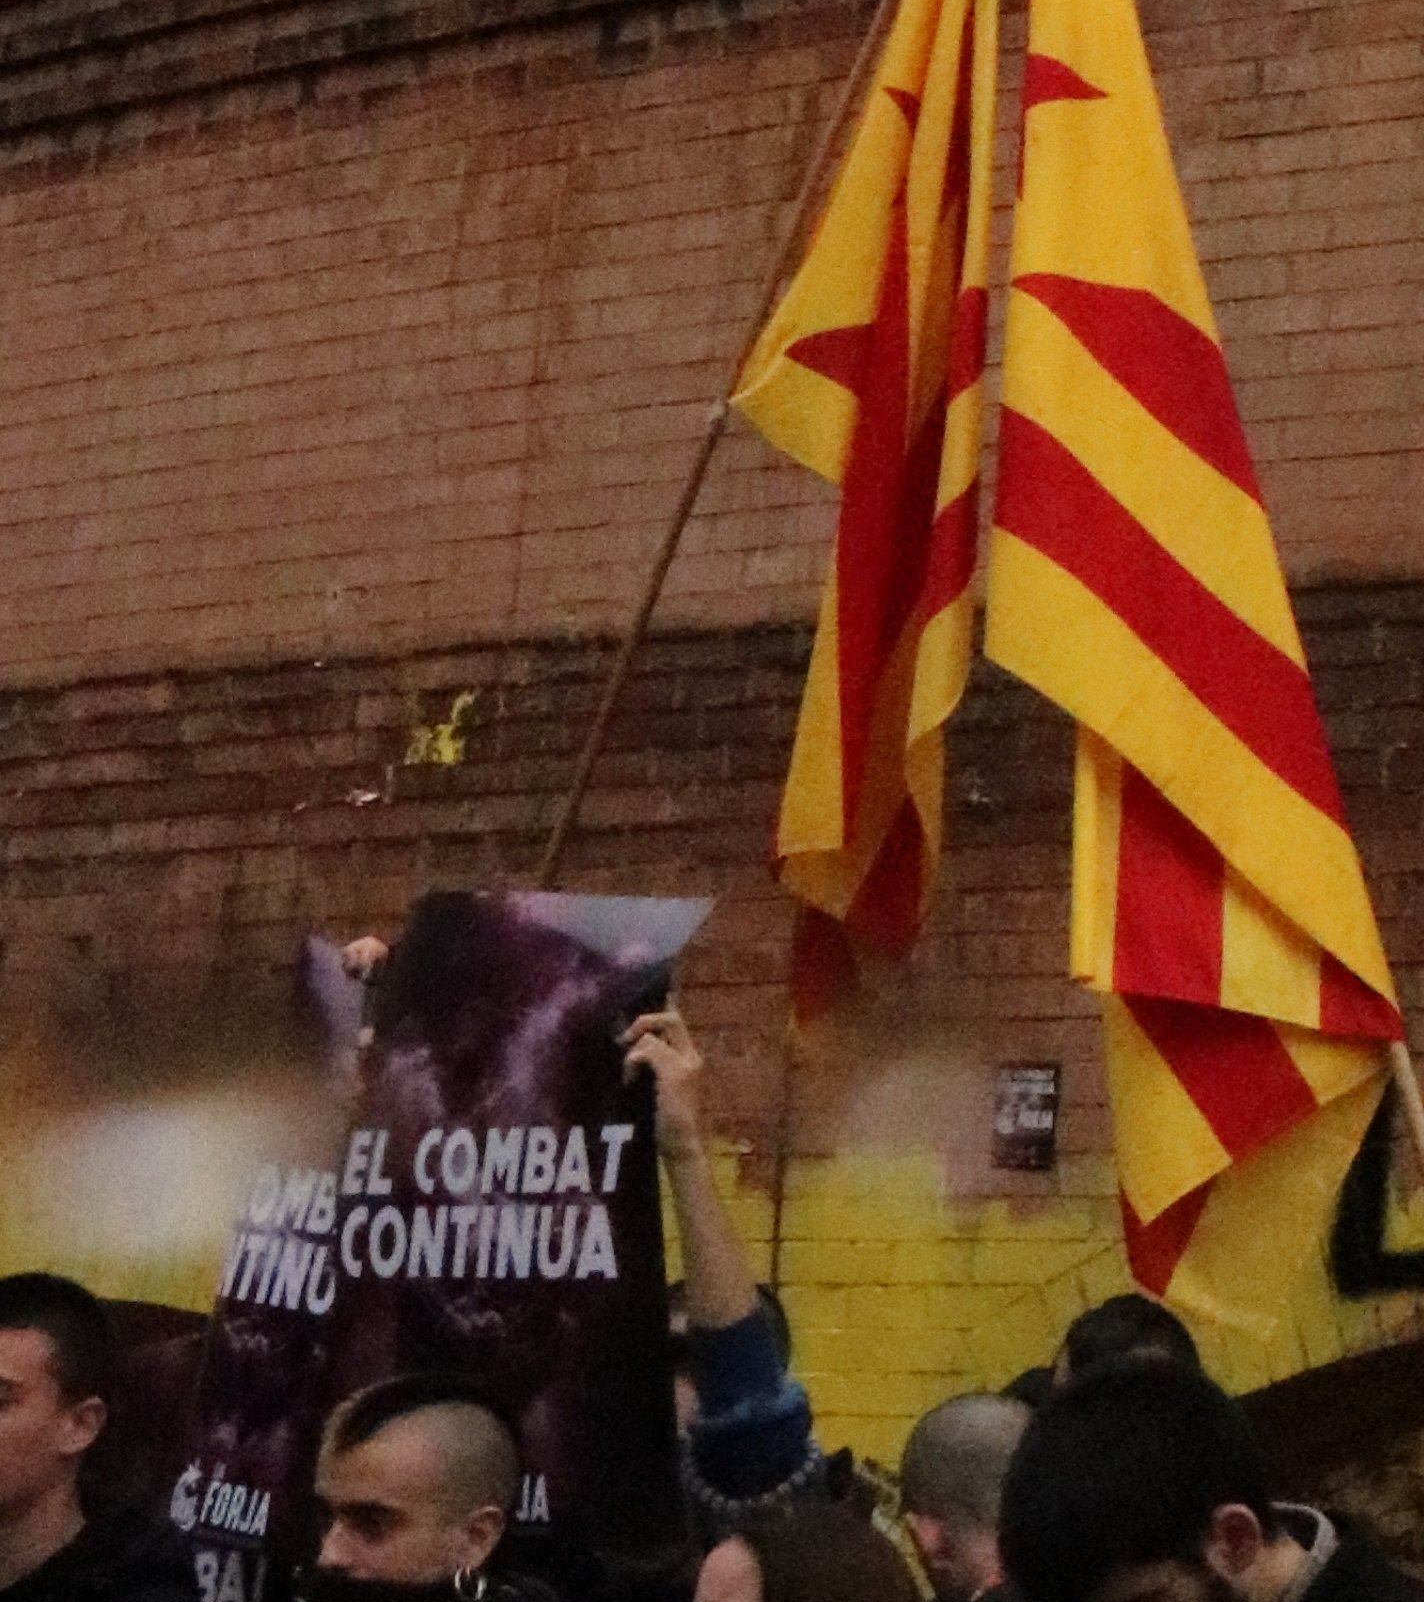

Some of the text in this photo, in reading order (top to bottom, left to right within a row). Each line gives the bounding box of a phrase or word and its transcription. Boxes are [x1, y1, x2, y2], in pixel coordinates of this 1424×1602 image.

[342, 1124, 634, 1195] EL COMBAT
[341, 1205, 618, 1280] CONTINUA
[200, 1480, 271, 1537] FORJA
